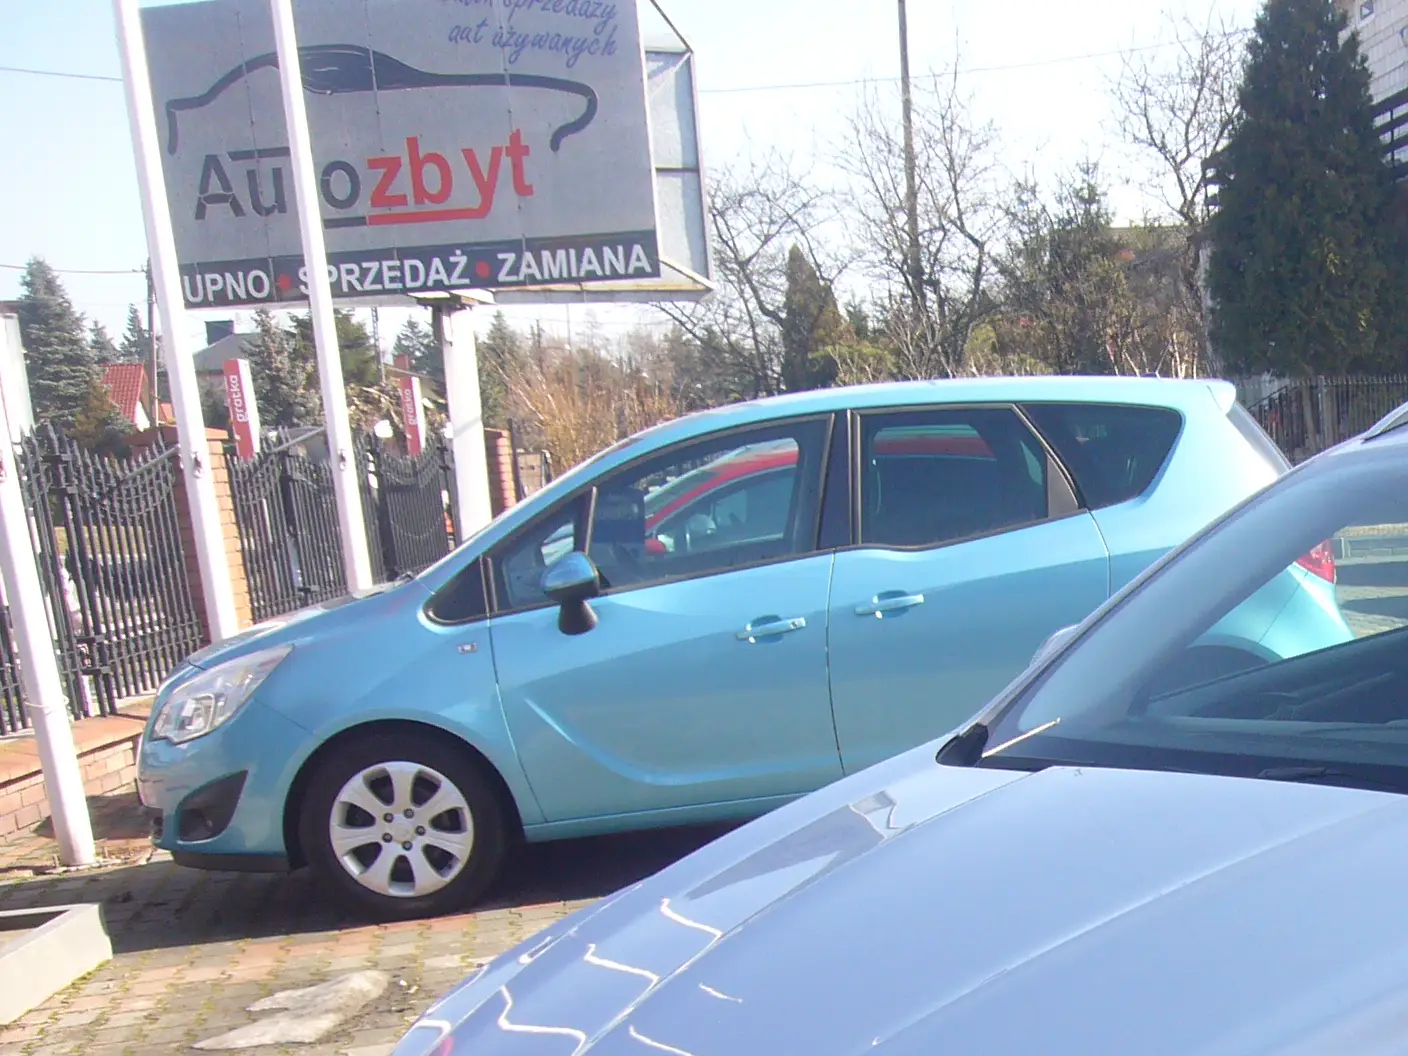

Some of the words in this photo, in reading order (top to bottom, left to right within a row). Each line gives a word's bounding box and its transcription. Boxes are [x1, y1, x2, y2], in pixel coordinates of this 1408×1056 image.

[194, 128, 534, 220] Auozbyt
[183, 270, 270, 303] UPNO
[497, 244, 652, 283] ZAMIANA
[229, 375, 249, 422] gratka
